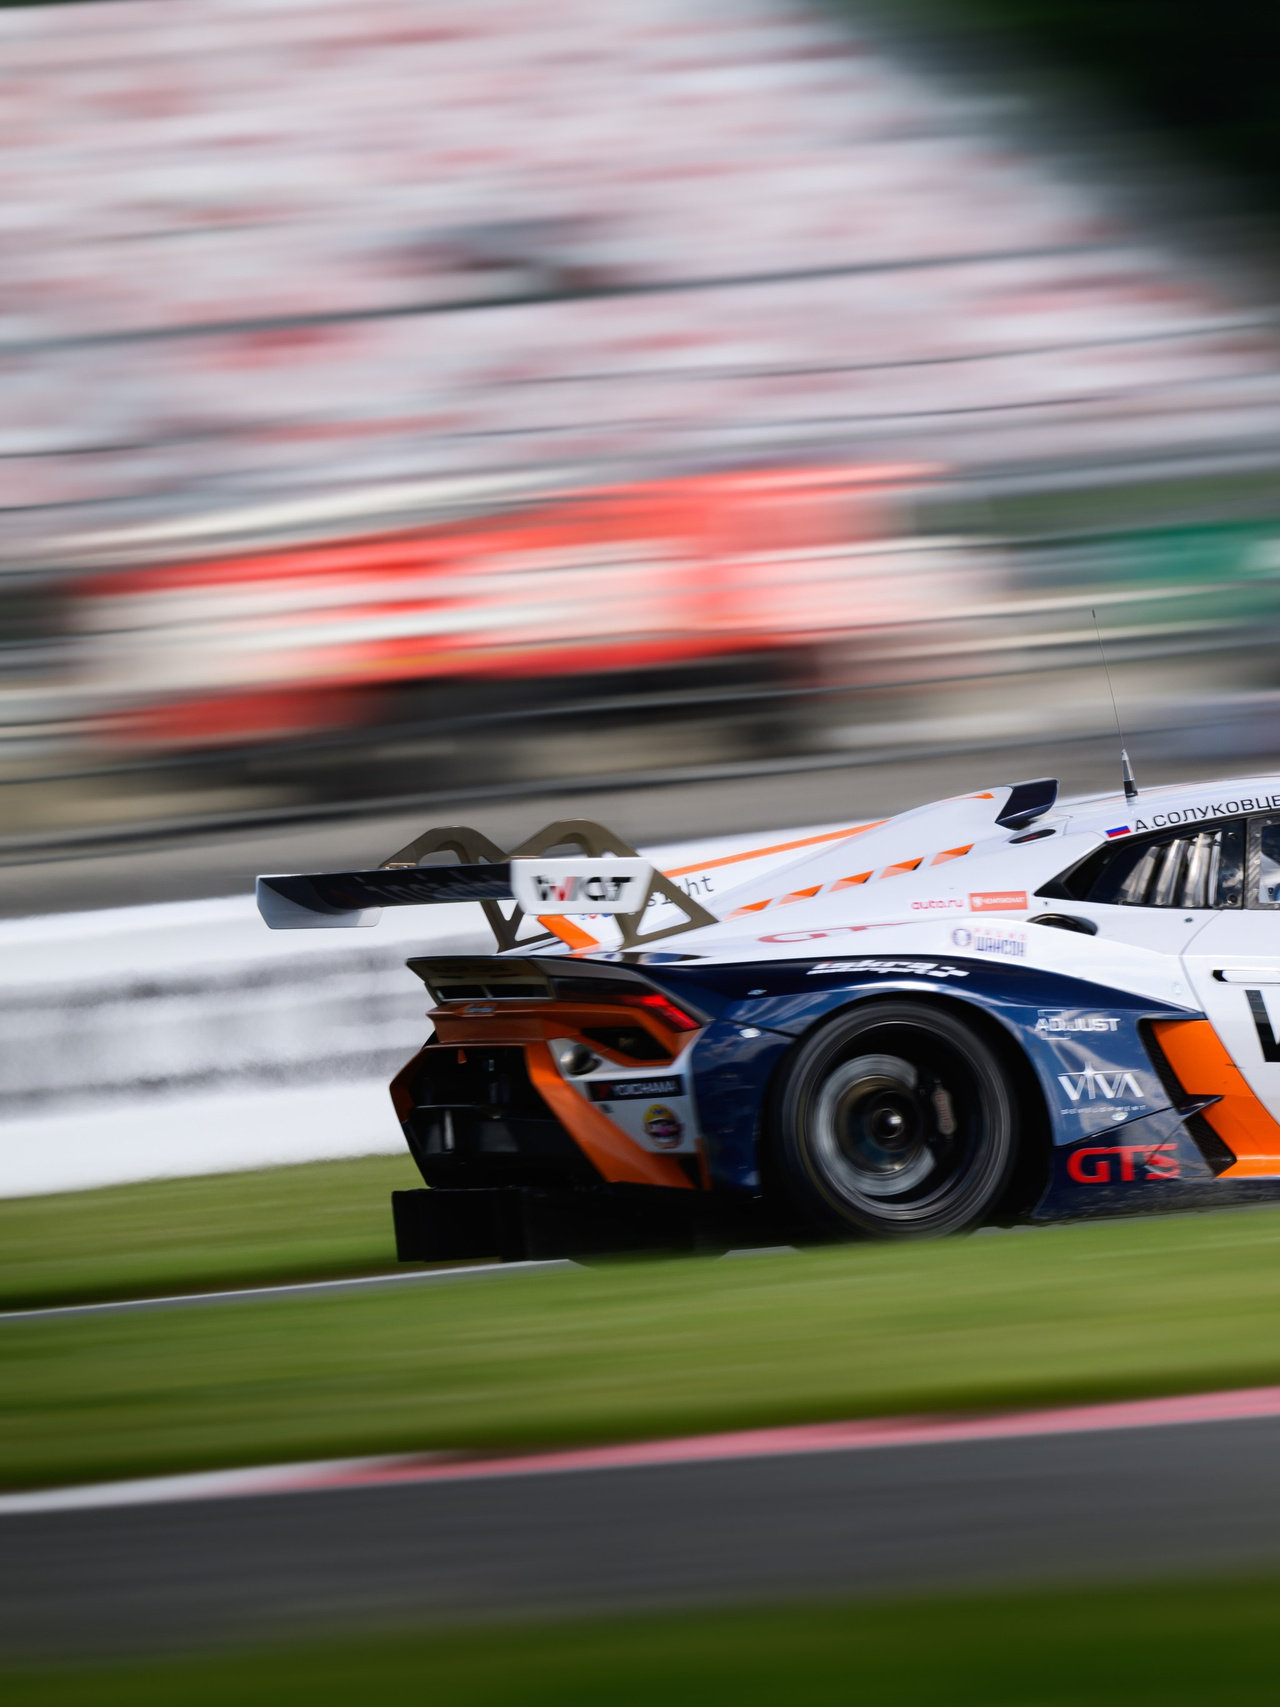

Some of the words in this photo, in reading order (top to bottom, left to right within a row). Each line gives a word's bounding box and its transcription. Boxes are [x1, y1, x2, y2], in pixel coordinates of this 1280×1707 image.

[911, 899, 964, 910] auto.ru
[1034, 1018, 1121, 1032] ADJUST
[1057, 1066, 1145, 1101] VIVA
[1066, 1143, 1181, 1184] GTS
